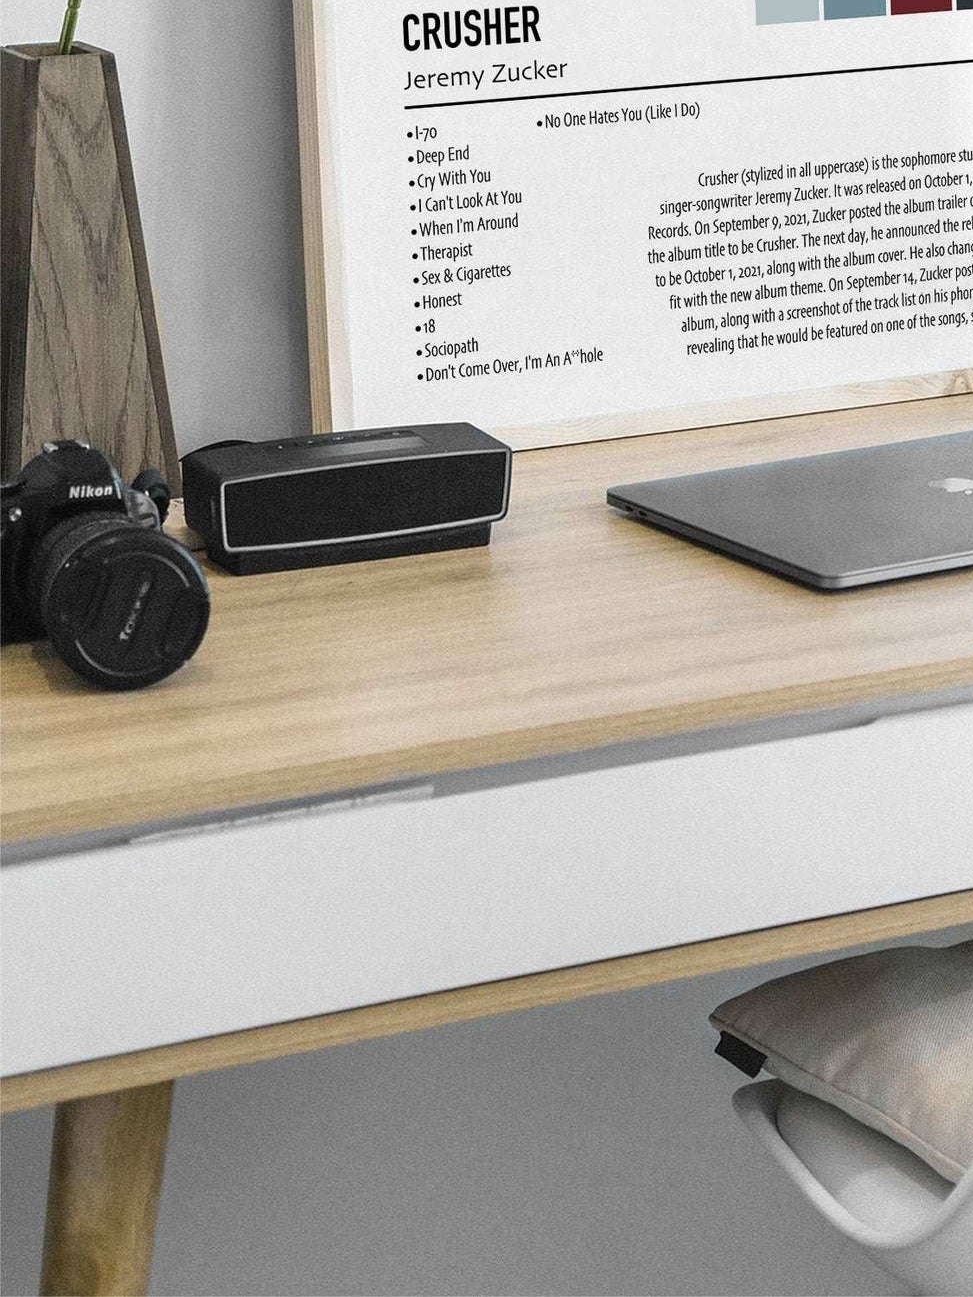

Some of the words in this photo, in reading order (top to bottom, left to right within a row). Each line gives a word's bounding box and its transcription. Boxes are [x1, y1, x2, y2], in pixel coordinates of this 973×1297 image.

[402, 5, 541, 52] CRUSHER
[404, 70, 485, 91] Jeremy
[492, 59, 568, 83] Zucker
[545, 114, 561, 129] No
[563, 112, 586, 127] One
[589, 110, 619, 125] Hates
[621, 107, 642, 122] You
[645, 103, 672, 124] (Like
[673, 103, 678, 118] I
[681, 102, 700, 119] Do)
[415, 125, 437, 142] I-70
[416, 149, 445, 167] Deep
[448, 144, 469, 161] End
[417, 173, 436, 192] Cry
[438, 169, 467, 186] With
[469, 169, 491, 183] You
[698, 170, 739, 187] Crusher
[741, 164, 783, 186] (stylized
[786, 164, 796, 179] in
[799, 162, 811, 178] all
[814, 157, 869, 179] uppercase)
[872, 156, 880, 170] is
[881, 154, 899, 169] the
[900, 151, 956, 171] sophomore
[417, 198, 422, 213] I
[425, 195, 454, 212] Can't
[456, 192, 483, 209] Look
[485, 192, 499, 207] At
[500, 190, 522, 205] You
[660, 193, 753, 218] singer-songwriter
[755, 191, 792, 206] Jeremy
[794, 185, 831, 202] Zucker.
[834, 184, 842, 197] It
[843, 184, 863, 196] was
[866, 176, 906, 194] released
[909, 178, 921, 190] on
[924, 172, 964, 189] October
[965, 174, 973, 186] 1,
[419, 220, 453, 237] When
[456, 218, 474, 233] I'm
[477, 212, 519, 231] Around
[648, 222, 692, 240] Records.
[694, 220, 710, 235] On
[713, 214, 770, 236] September
[772, 216, 782, 230] 9,
[784, 213, 810, 226] 2021,
[812, 206, 847, 223] Zucker
[849, 202, 881, 223] posted
[884, 201, 901, 216] the
[903, 199, 935, 214] album
[937, 194, 968, 210] trailer
[420, 242, 473, 262] Therapist
[655, 274, 666, 287] to
[669, 271, 682, 286] be
[684, 266, 726, 284] October
[728, 269, 736, 282] 1,
[738, 266, 764, 278] 2021,
[766, 260, 795, 277] along
[798, 255, 821, 271] with
[823, 254, 841, 269] the
[843, 251, 875, 267] album
[878, 250, 907, 263] cover.
[909, 246, 924, 260] He
[925, 243, 945, 258] also
[421, 270, 441, 286] Sex
[444, 268, 453, 283] &
[456, 264, 511, 285] Cigarettes
[669, 294, 682, 309] fit
[683, 291, 708, 308] with
[710, 290, 728, 305] the
[730, 290, 752, 303] new
[754, 284, 787, 300] album
[790, 281, 826, 296] theme.
[828, 277, 844, 292] On
[846, 271, 901, 293] September
[903, 272, 917, 285] 14,
[919, 265, 953, 282] Zucker
[422, 292, 462, 310] Honest
[681, 316, 718, 333] album,
[720, 312, 749, 329] along
[752, 307, 775, 324] with
[778, 310, 784, 321] a
[787, 301, 841, 320] screenshot
[842, 298, 853, 314] of
[855, 297, 872, 312] the
[874, 293, 899, 310] track
[901, 292, 916, 307] list
[918, 293, 931, 305] on
[934, 289, 948, 303] his
[423, 318, 436, 333] 18
[687, 337, 735, 355] revealing
[737, 334, 759, 349] that
[761, 332, 774, 347] he
[776, 327, 808, 345] would
[811, 326, 824, 341] be
[826, 320, 868, 339] featured
[870, 322, 884, 334] on
[886, 319, 905, 332] one
[907, 314, 917, 330] of
[919, 313, 936, 328] the
[938, 312, 969, 328] songs,
[425, 337, 479, 359] Sociopath
[426, 364, 456, 382] Don't
[458, 363, 490, 378] Come
[493, 359, 522, 374] Over,
[525, 355, 542, 370] I'm
[545, 353, 560, 368] An
[69, 485, 113, 499] Nikon
